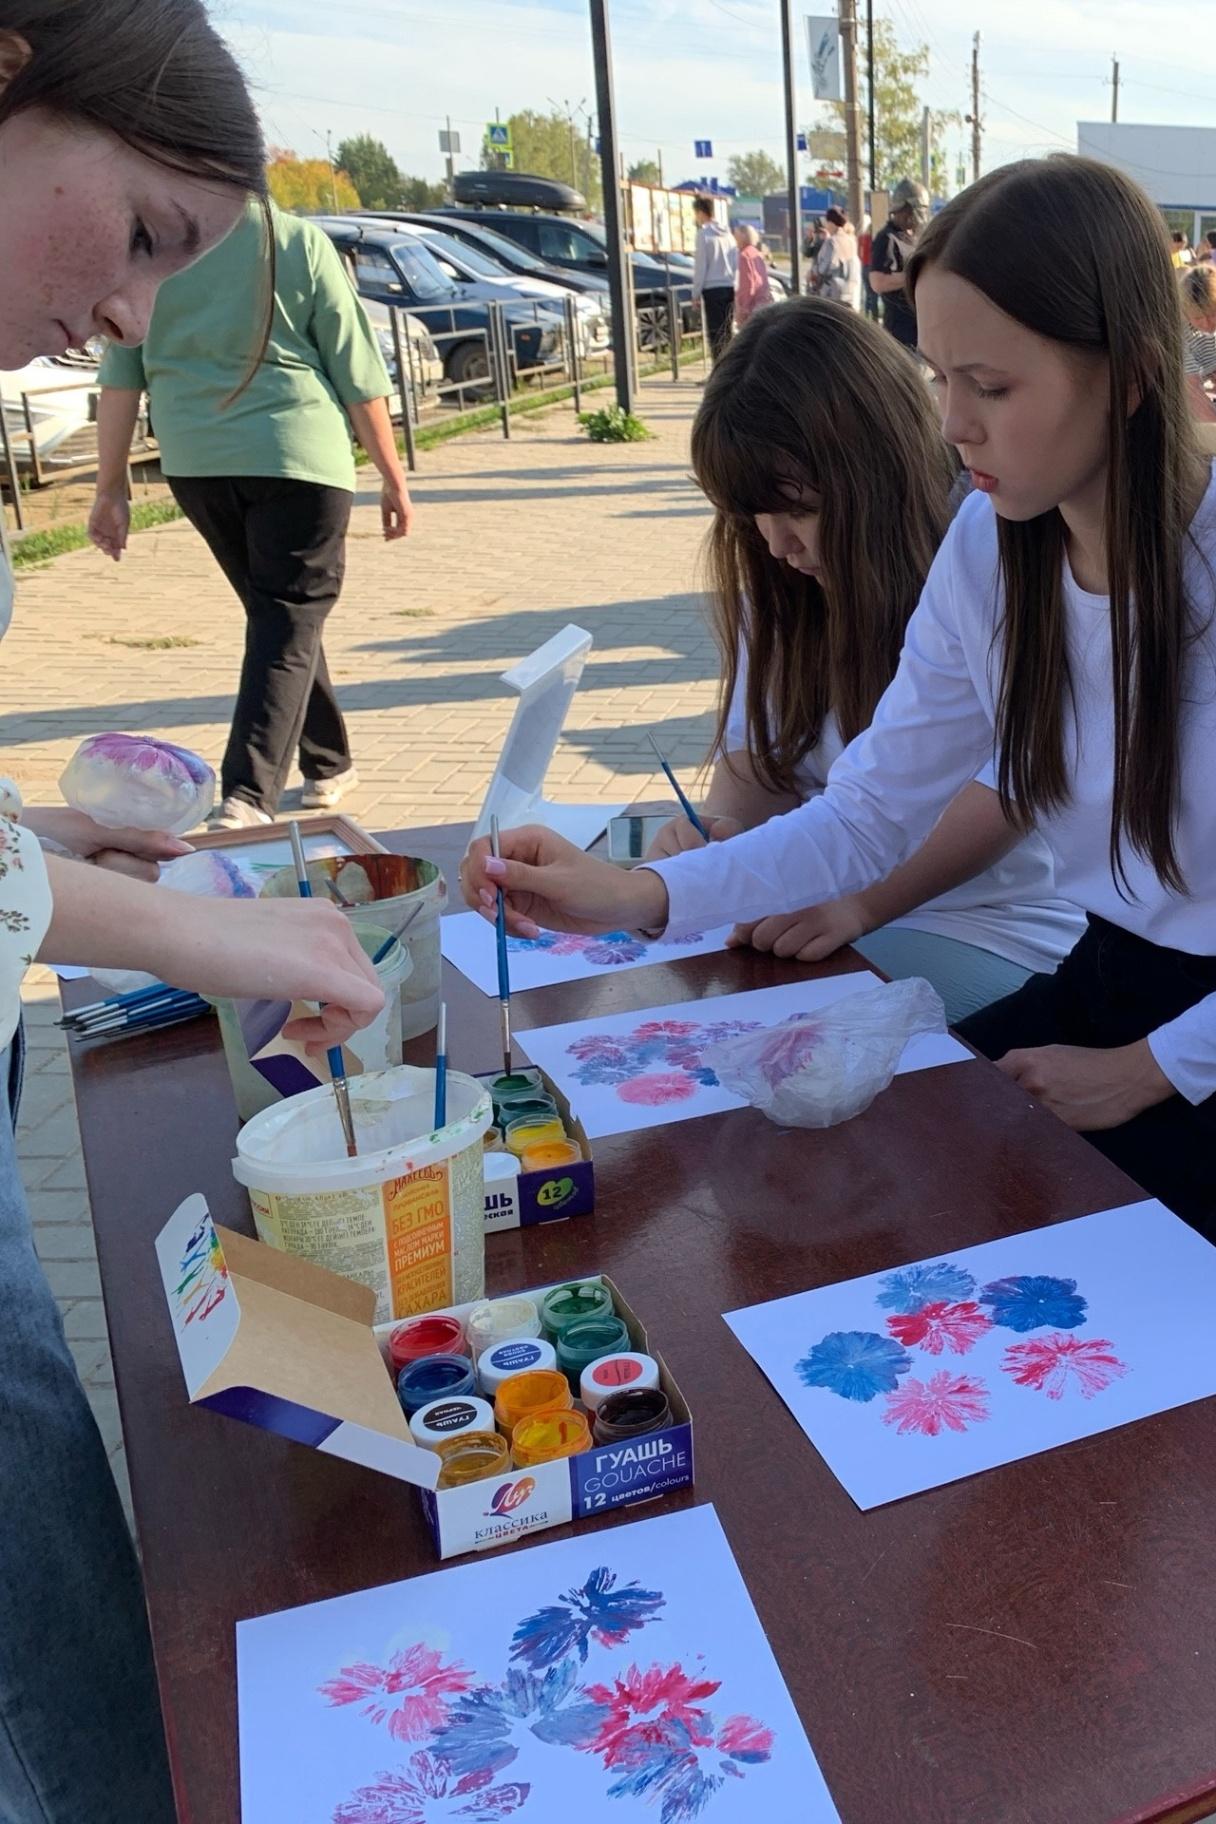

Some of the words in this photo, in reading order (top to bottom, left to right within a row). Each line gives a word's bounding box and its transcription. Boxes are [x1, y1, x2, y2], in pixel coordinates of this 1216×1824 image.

[543, 1186, 562, 1201] 12
[392, 1212, 412, 1235] БЕЗ
[416, 1200, 444, 1223] ГМО
[394, 1240, 445, 1273] ПРЕМИУМ
[436, 1415, 470, 1427] ГУАШЬ
[584, 1451, 686, 1493] GOUACHE
[596, 1439, 672, 1473] ГУАШЬ
[584, 1493, 606, 1510] 12
